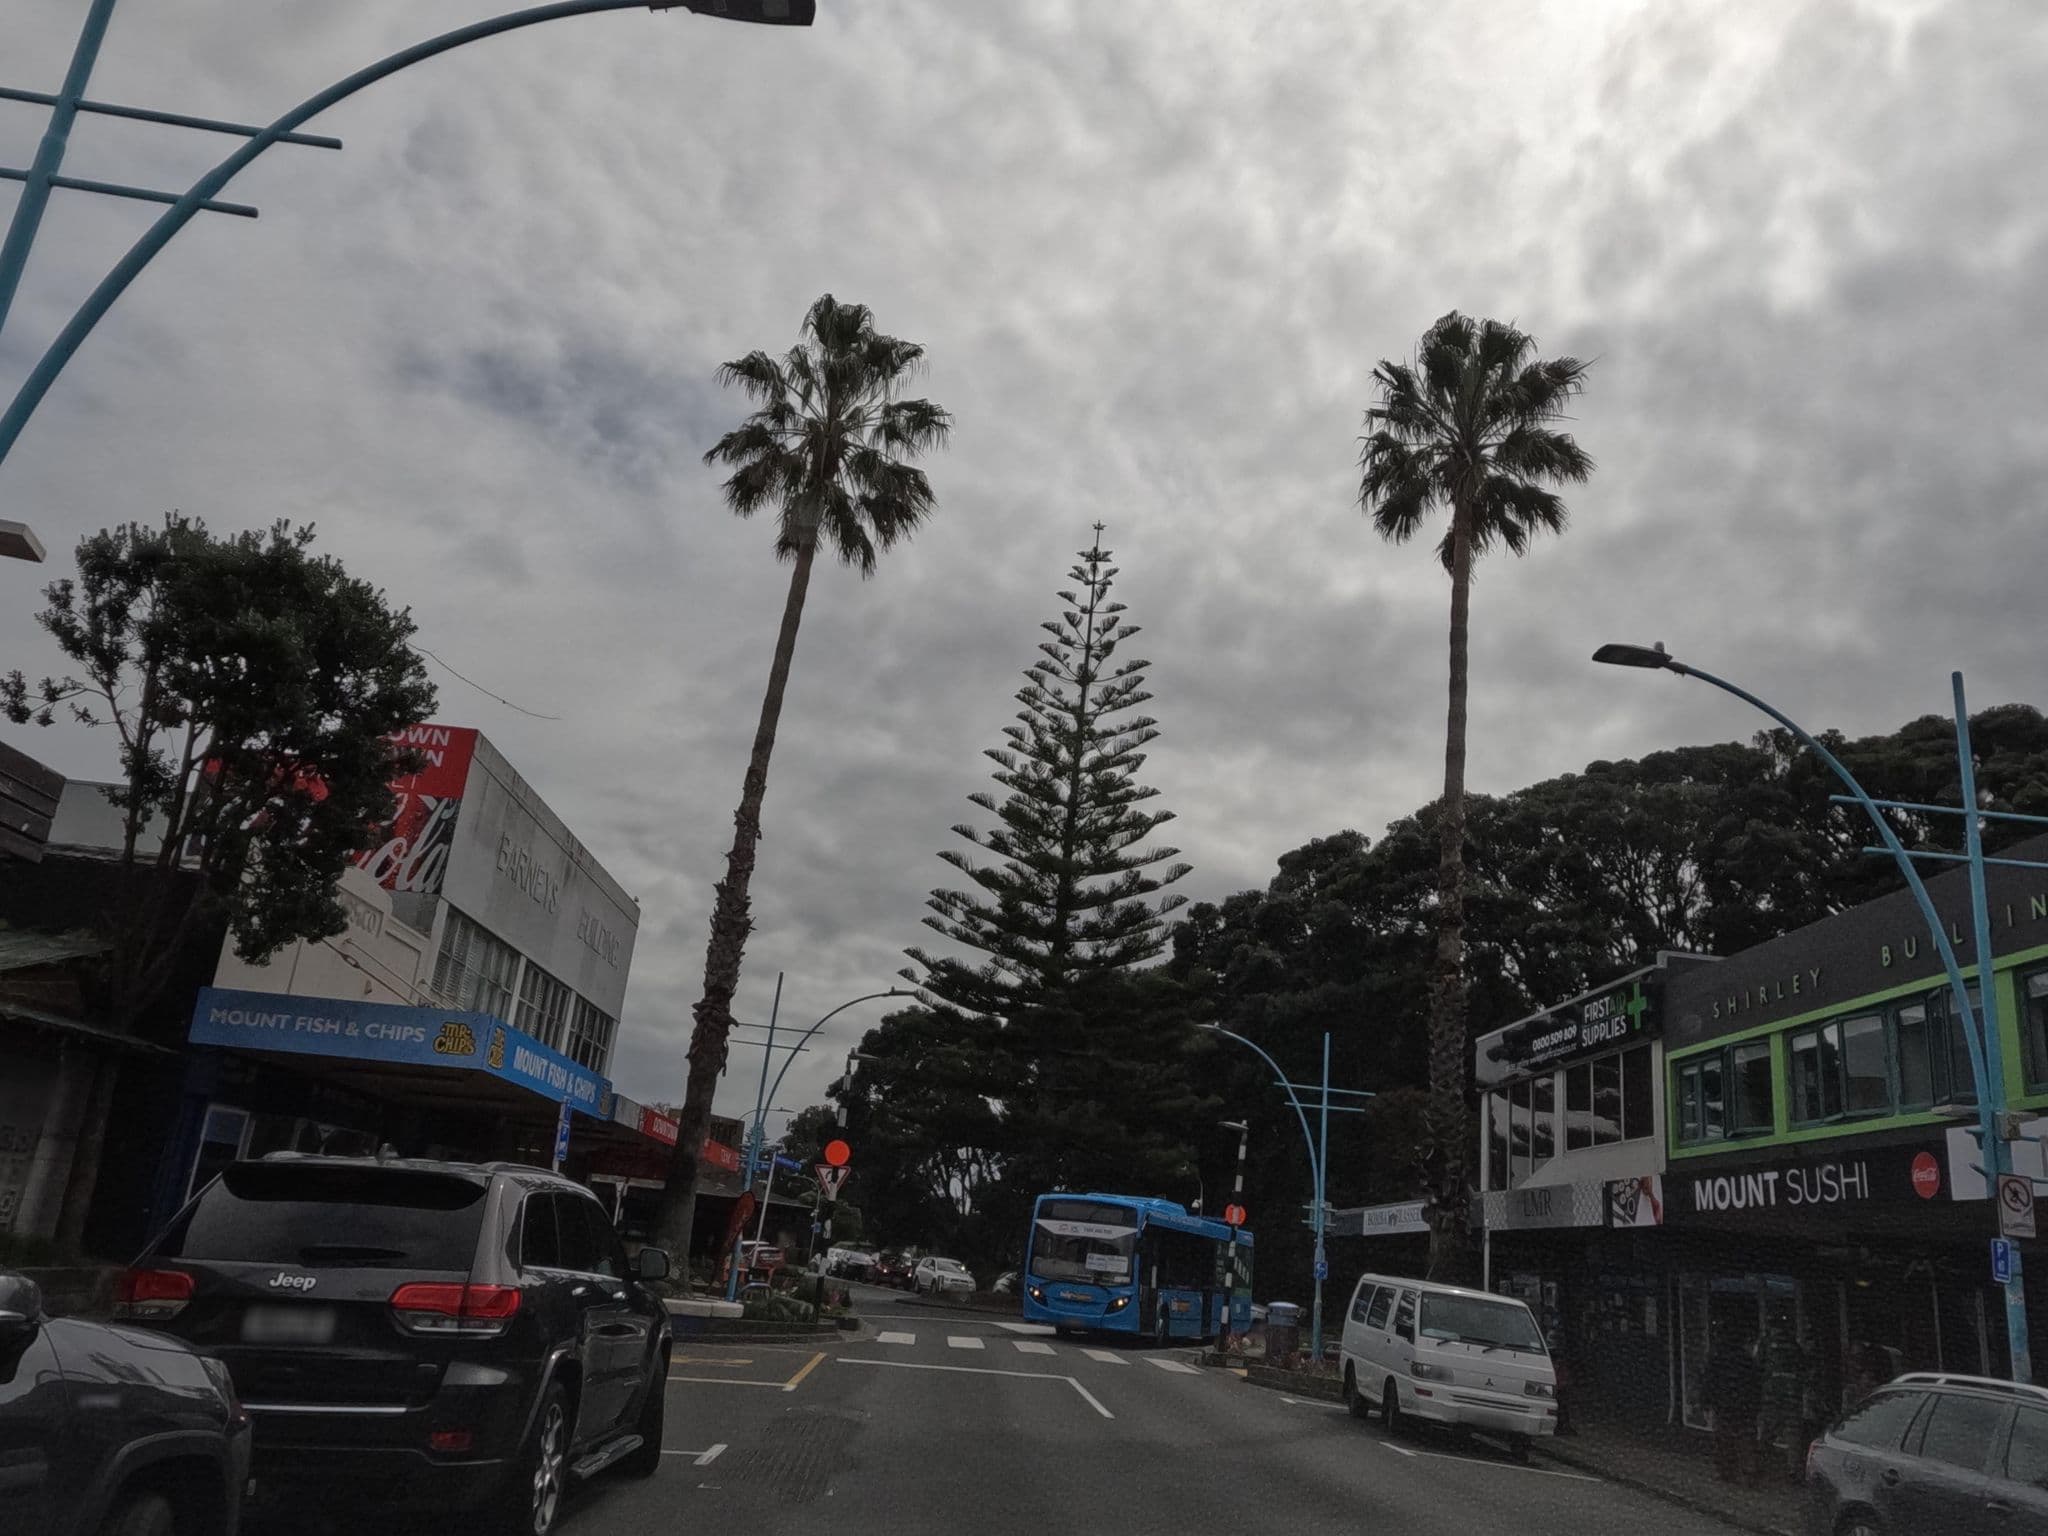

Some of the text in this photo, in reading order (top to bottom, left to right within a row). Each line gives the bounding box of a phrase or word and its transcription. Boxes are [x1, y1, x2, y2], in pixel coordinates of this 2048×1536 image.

[1713, 967, 1821, 1019] SHIRLEY
[209, 1008, 426, 1042] MOUNT FISH & CHIPS
[1581, 1015, 1628, 1048] SUPPLIES
[434, 1036, 475, 1054] CHIPS
[1532, 1034, 1551, 1052] 0800
[513, 1045, 548, 1081] MOUNT
[547, 1059, 568, 1090] FISH
[566, 1073, 575, 1094] &
[574, 1077, 597, 1104] CHIPS
[1694, 1161, 1869, 1212] MOUNT SUSHI
[269, 1272, 317, 1292] Jeep
